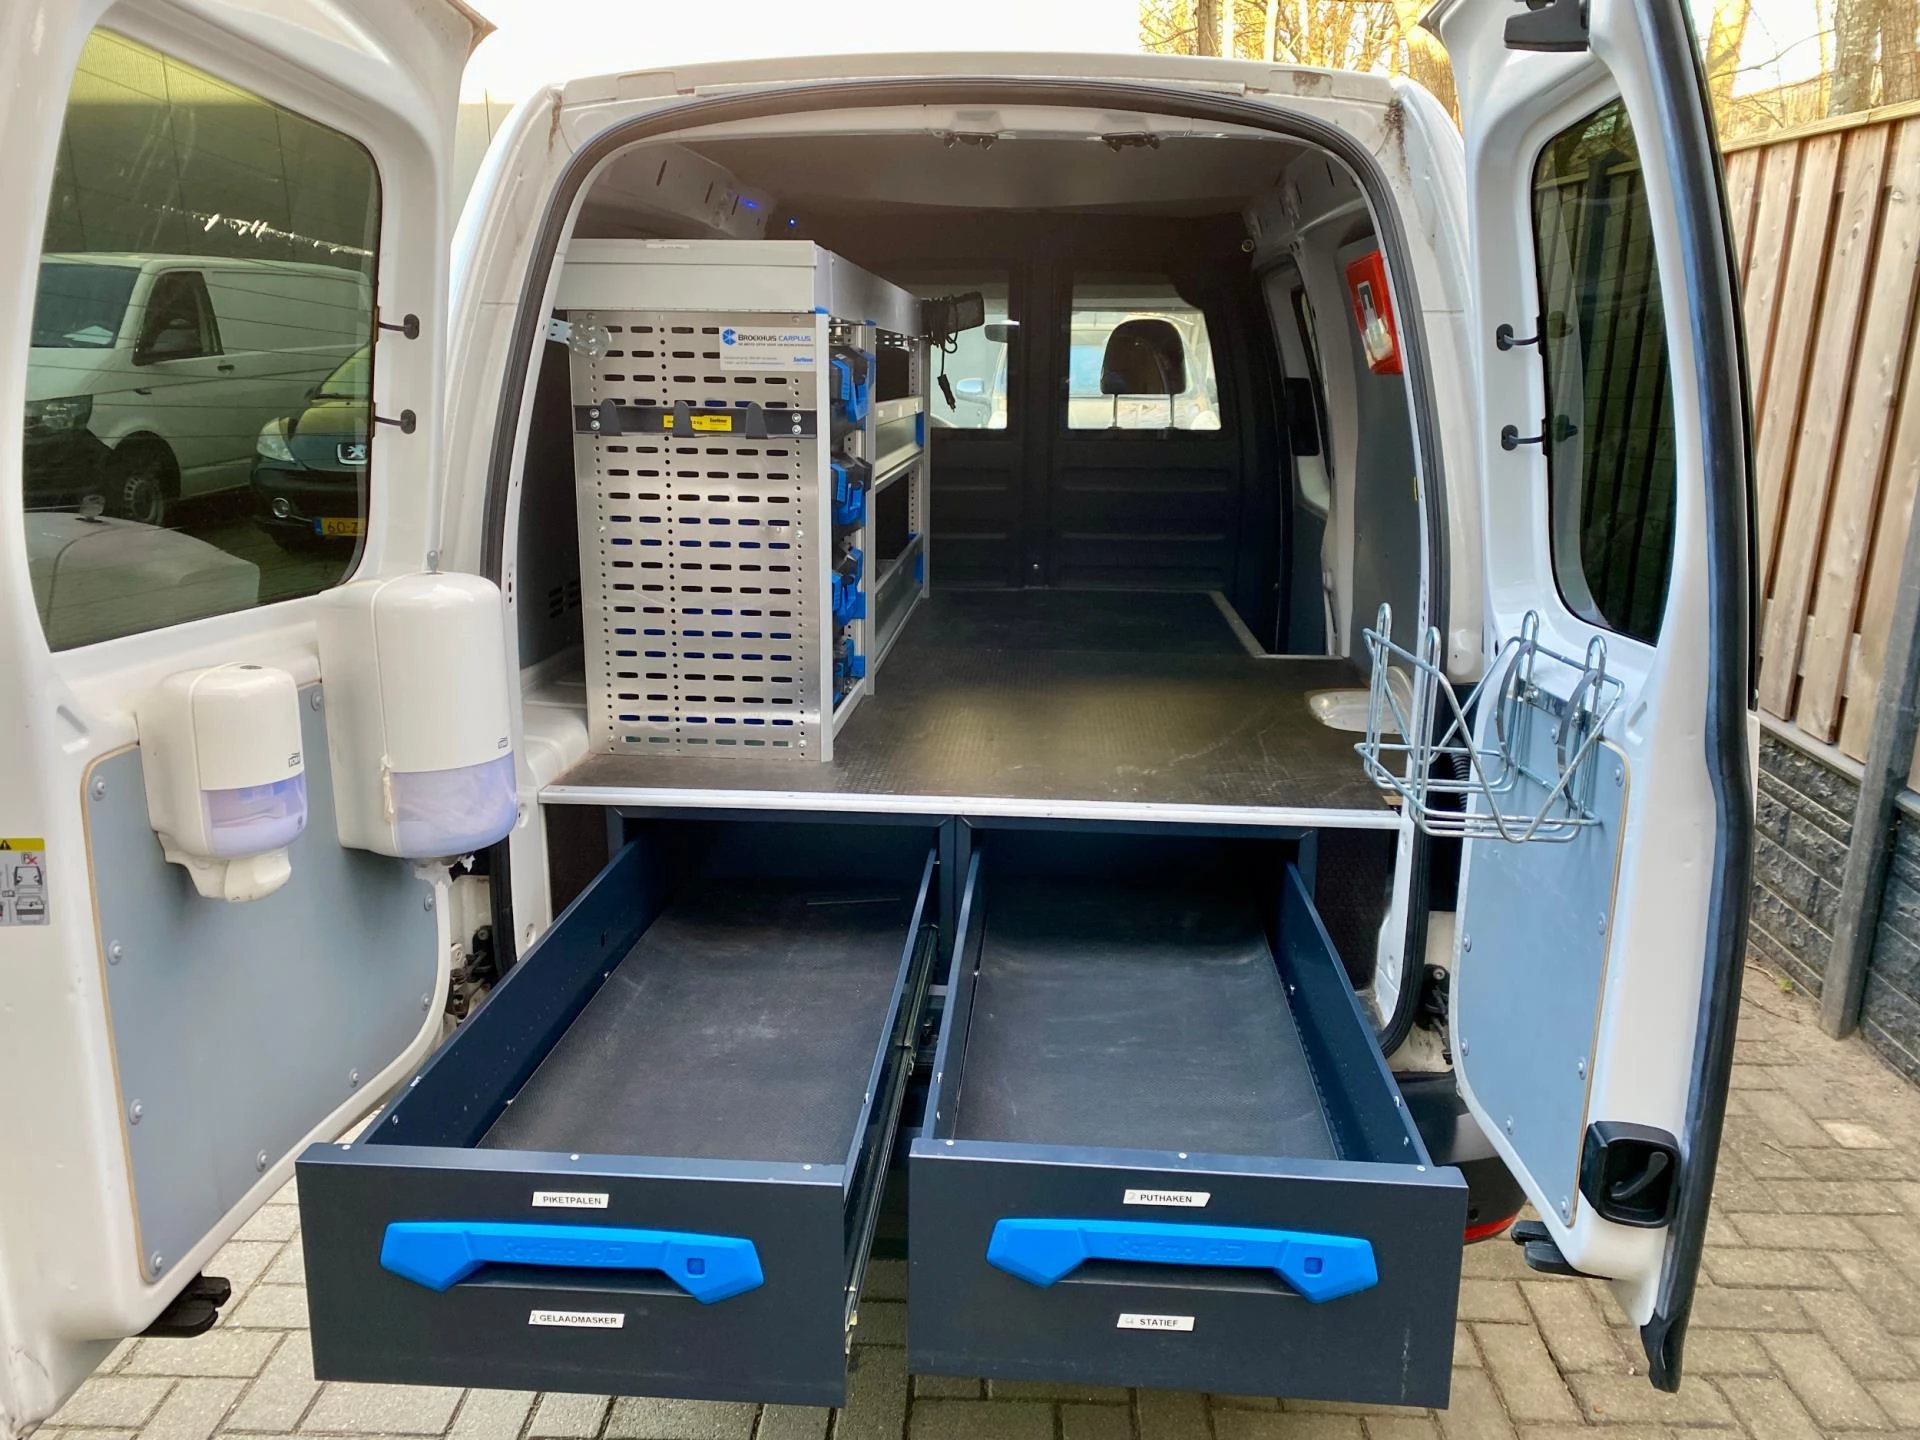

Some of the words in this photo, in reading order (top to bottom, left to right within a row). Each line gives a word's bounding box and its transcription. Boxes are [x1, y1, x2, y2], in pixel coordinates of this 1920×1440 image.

[543, 1196, 601, 1205] PIKETPALEN
[1140, 1194, 1192, 1203] PUTHAKEN
[540, 1315, 617, 1324] GELAADMASKER
[1140, 1318, 1178, 1327] STATIEF
